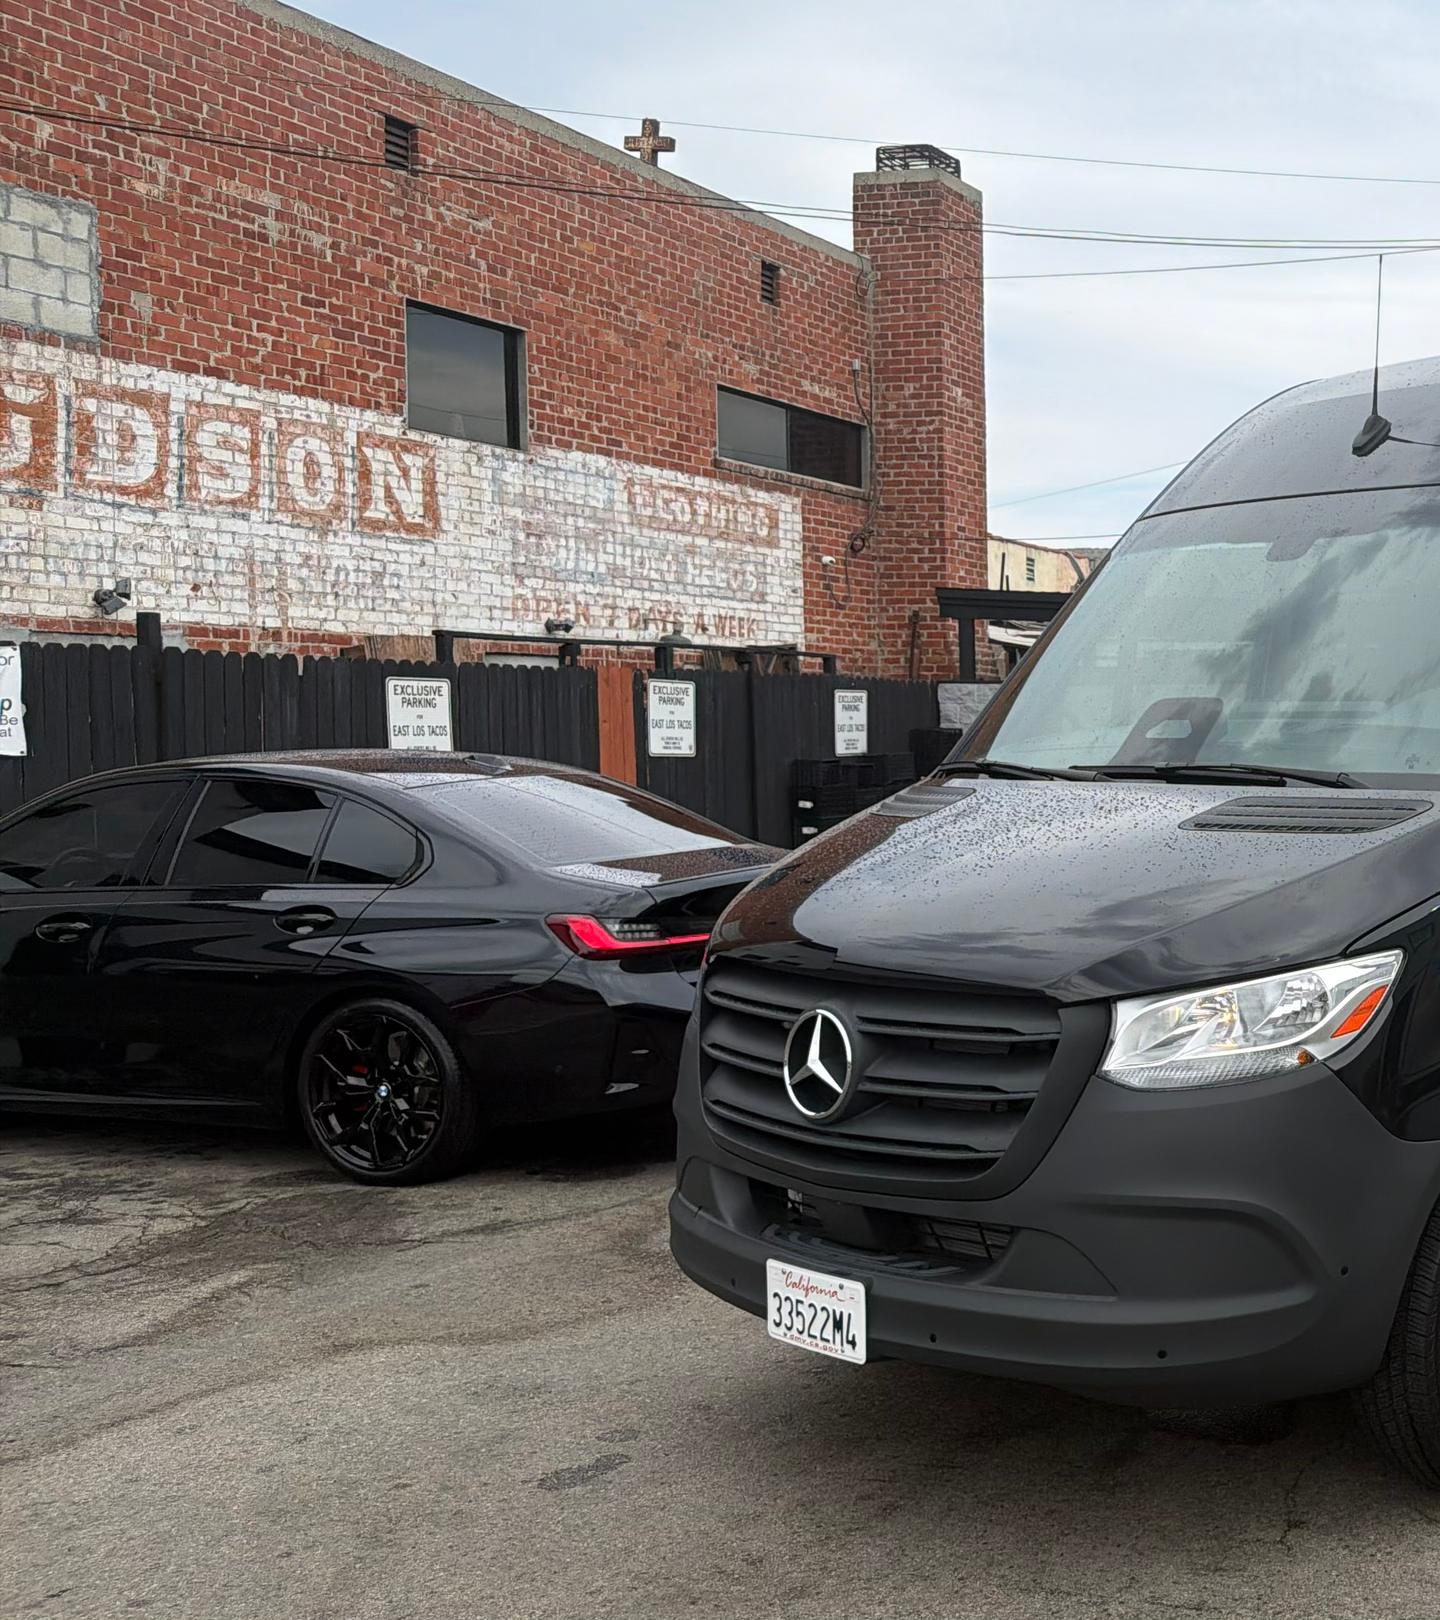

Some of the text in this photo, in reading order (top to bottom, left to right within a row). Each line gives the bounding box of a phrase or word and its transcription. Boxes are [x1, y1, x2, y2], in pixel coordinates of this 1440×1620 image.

[713, 612, 758, 640] WEEK
[393, 684, 444, 697] EXCLUSIVE
[652, 685, 690, 697] EXCLUSIVE
[401, 696, 437, 709] PARKING
[658, 696, 685, 707] PARKING
[838, 695, 864, 704] EXCLUSIVE
[841, 704, 861, 713] PARKING
[651, 719, 692, 730] EAST LOS TACOS
[392, 725, 448, 737] EAST LOS TACOS
[784, 1270, 847, 1302] California
[773, 1291, 857, 1351] 33522M4
